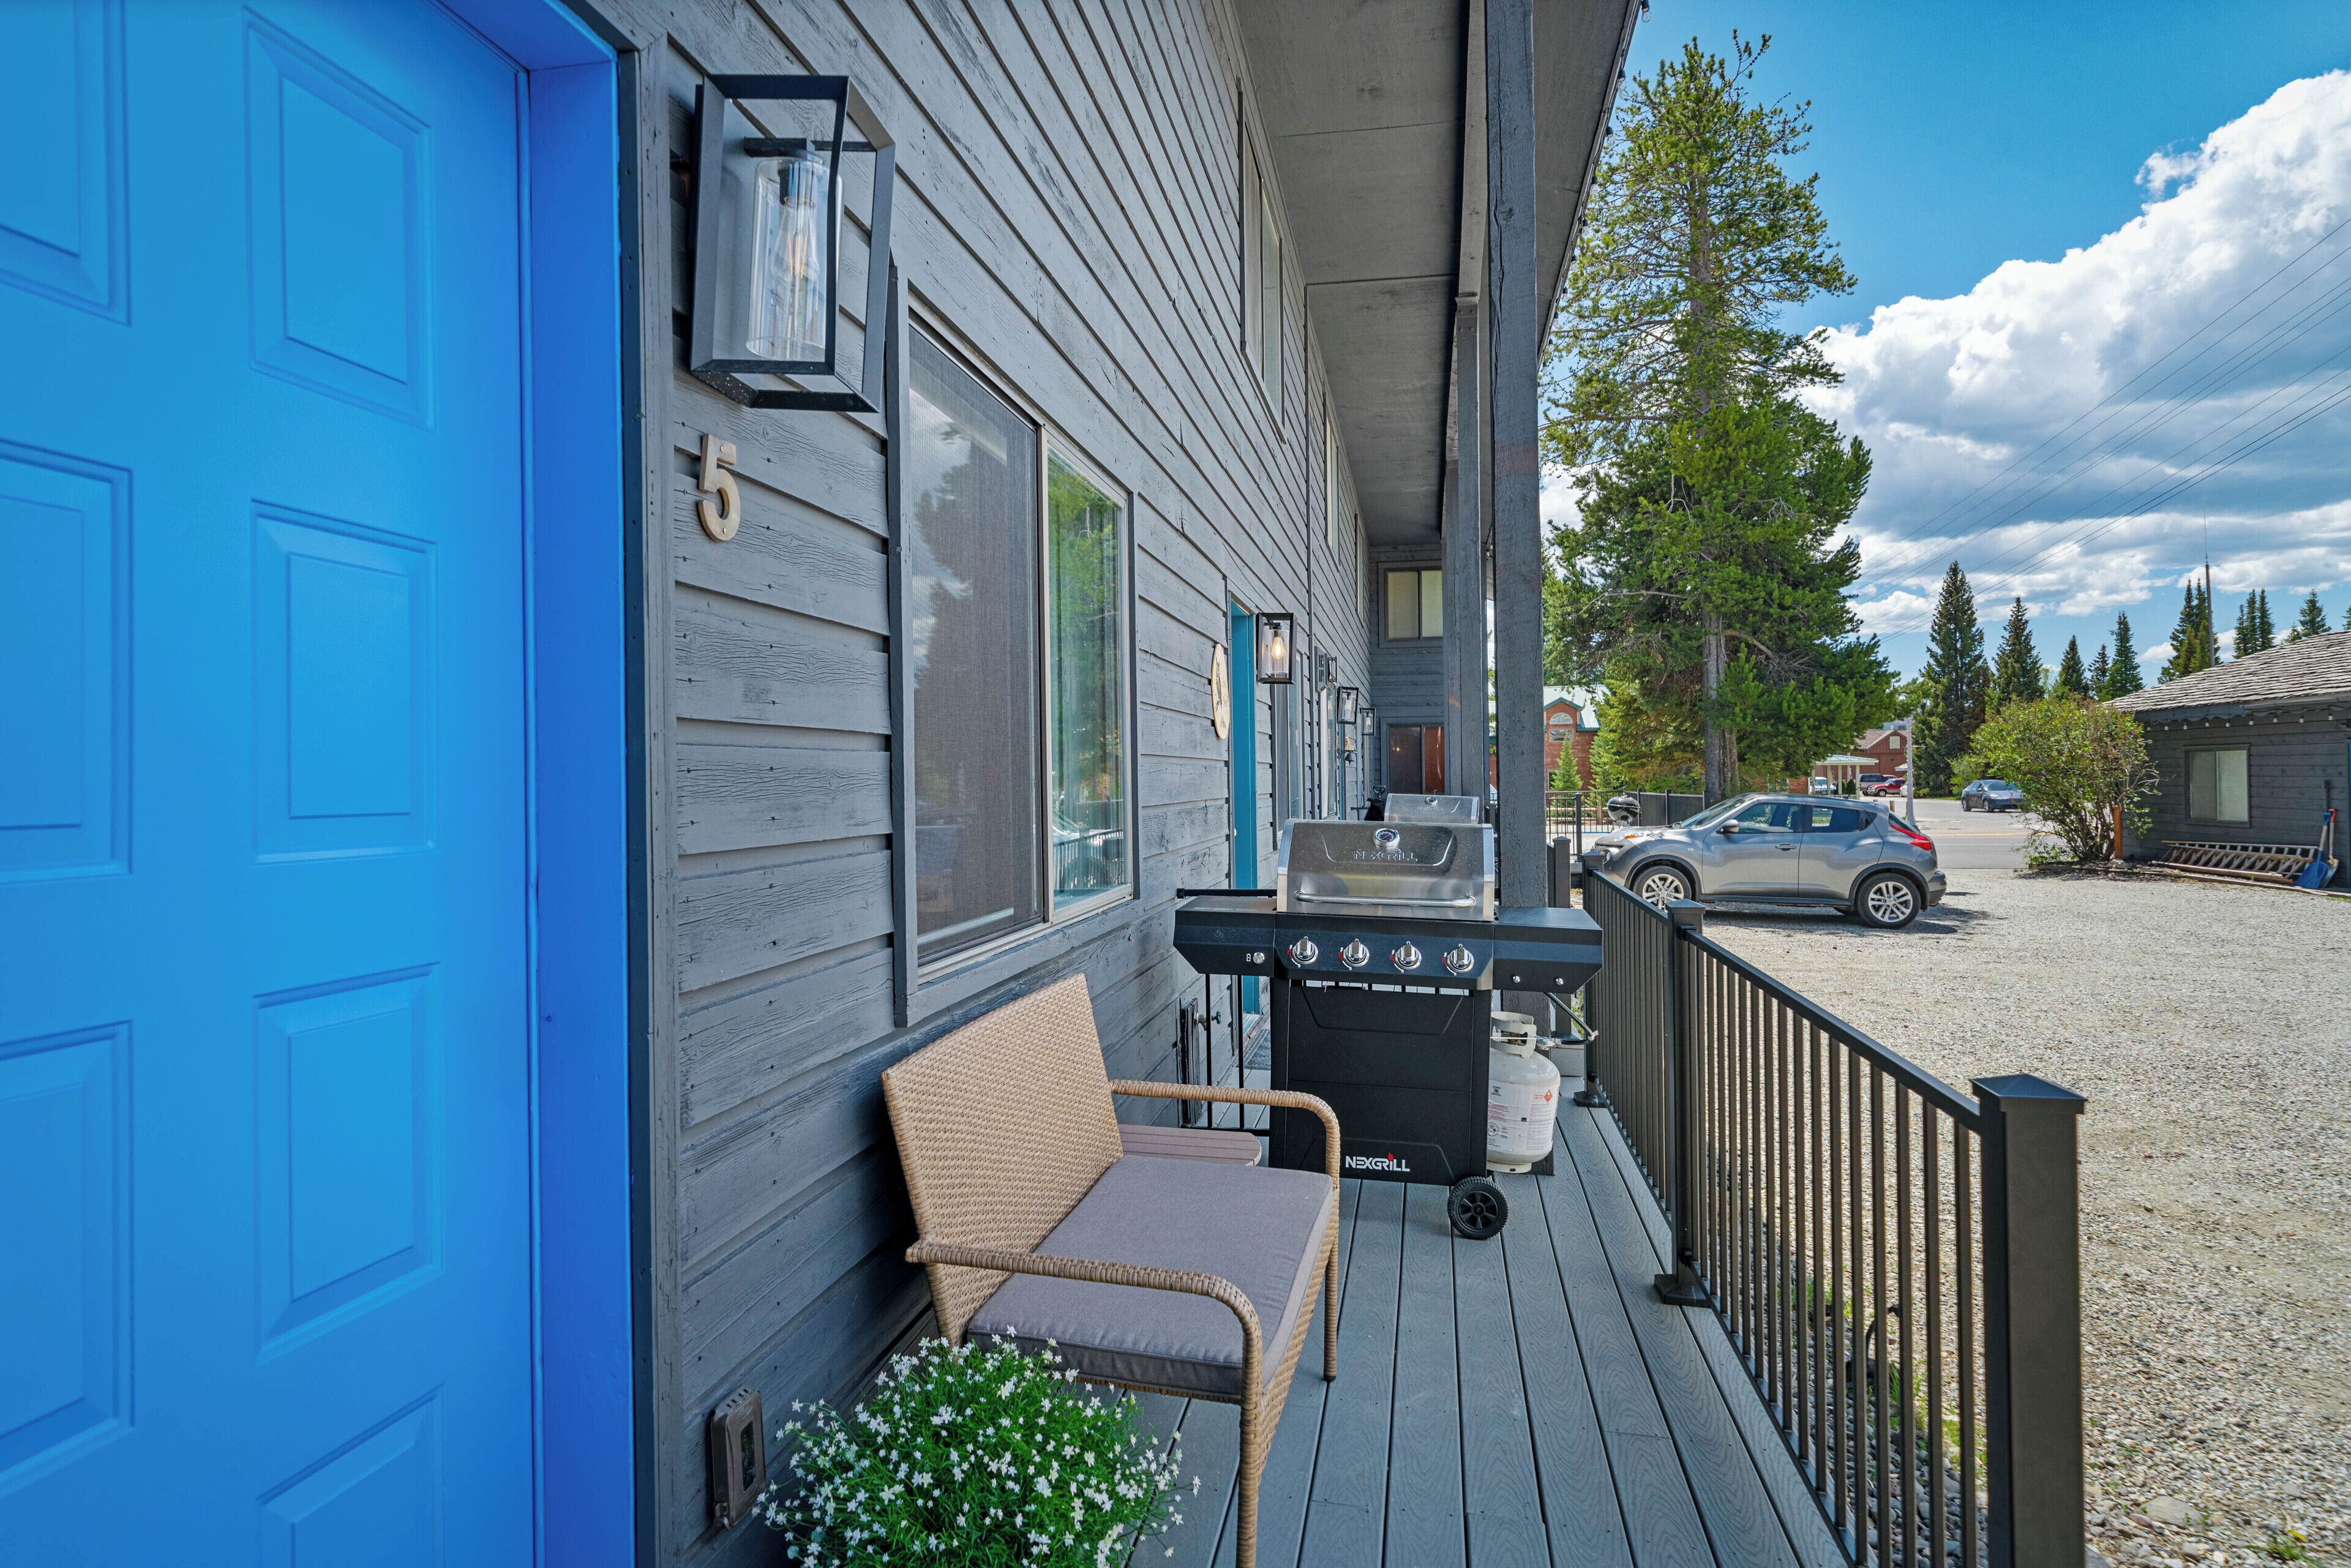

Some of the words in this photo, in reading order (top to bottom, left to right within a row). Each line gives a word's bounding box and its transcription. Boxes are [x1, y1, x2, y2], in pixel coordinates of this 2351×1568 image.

[699, 433, 741, 541] 5
[1353, 849, 1418, 861] NXGRILL
[1346, 1153, 1410, 1172] NEXGRILL
